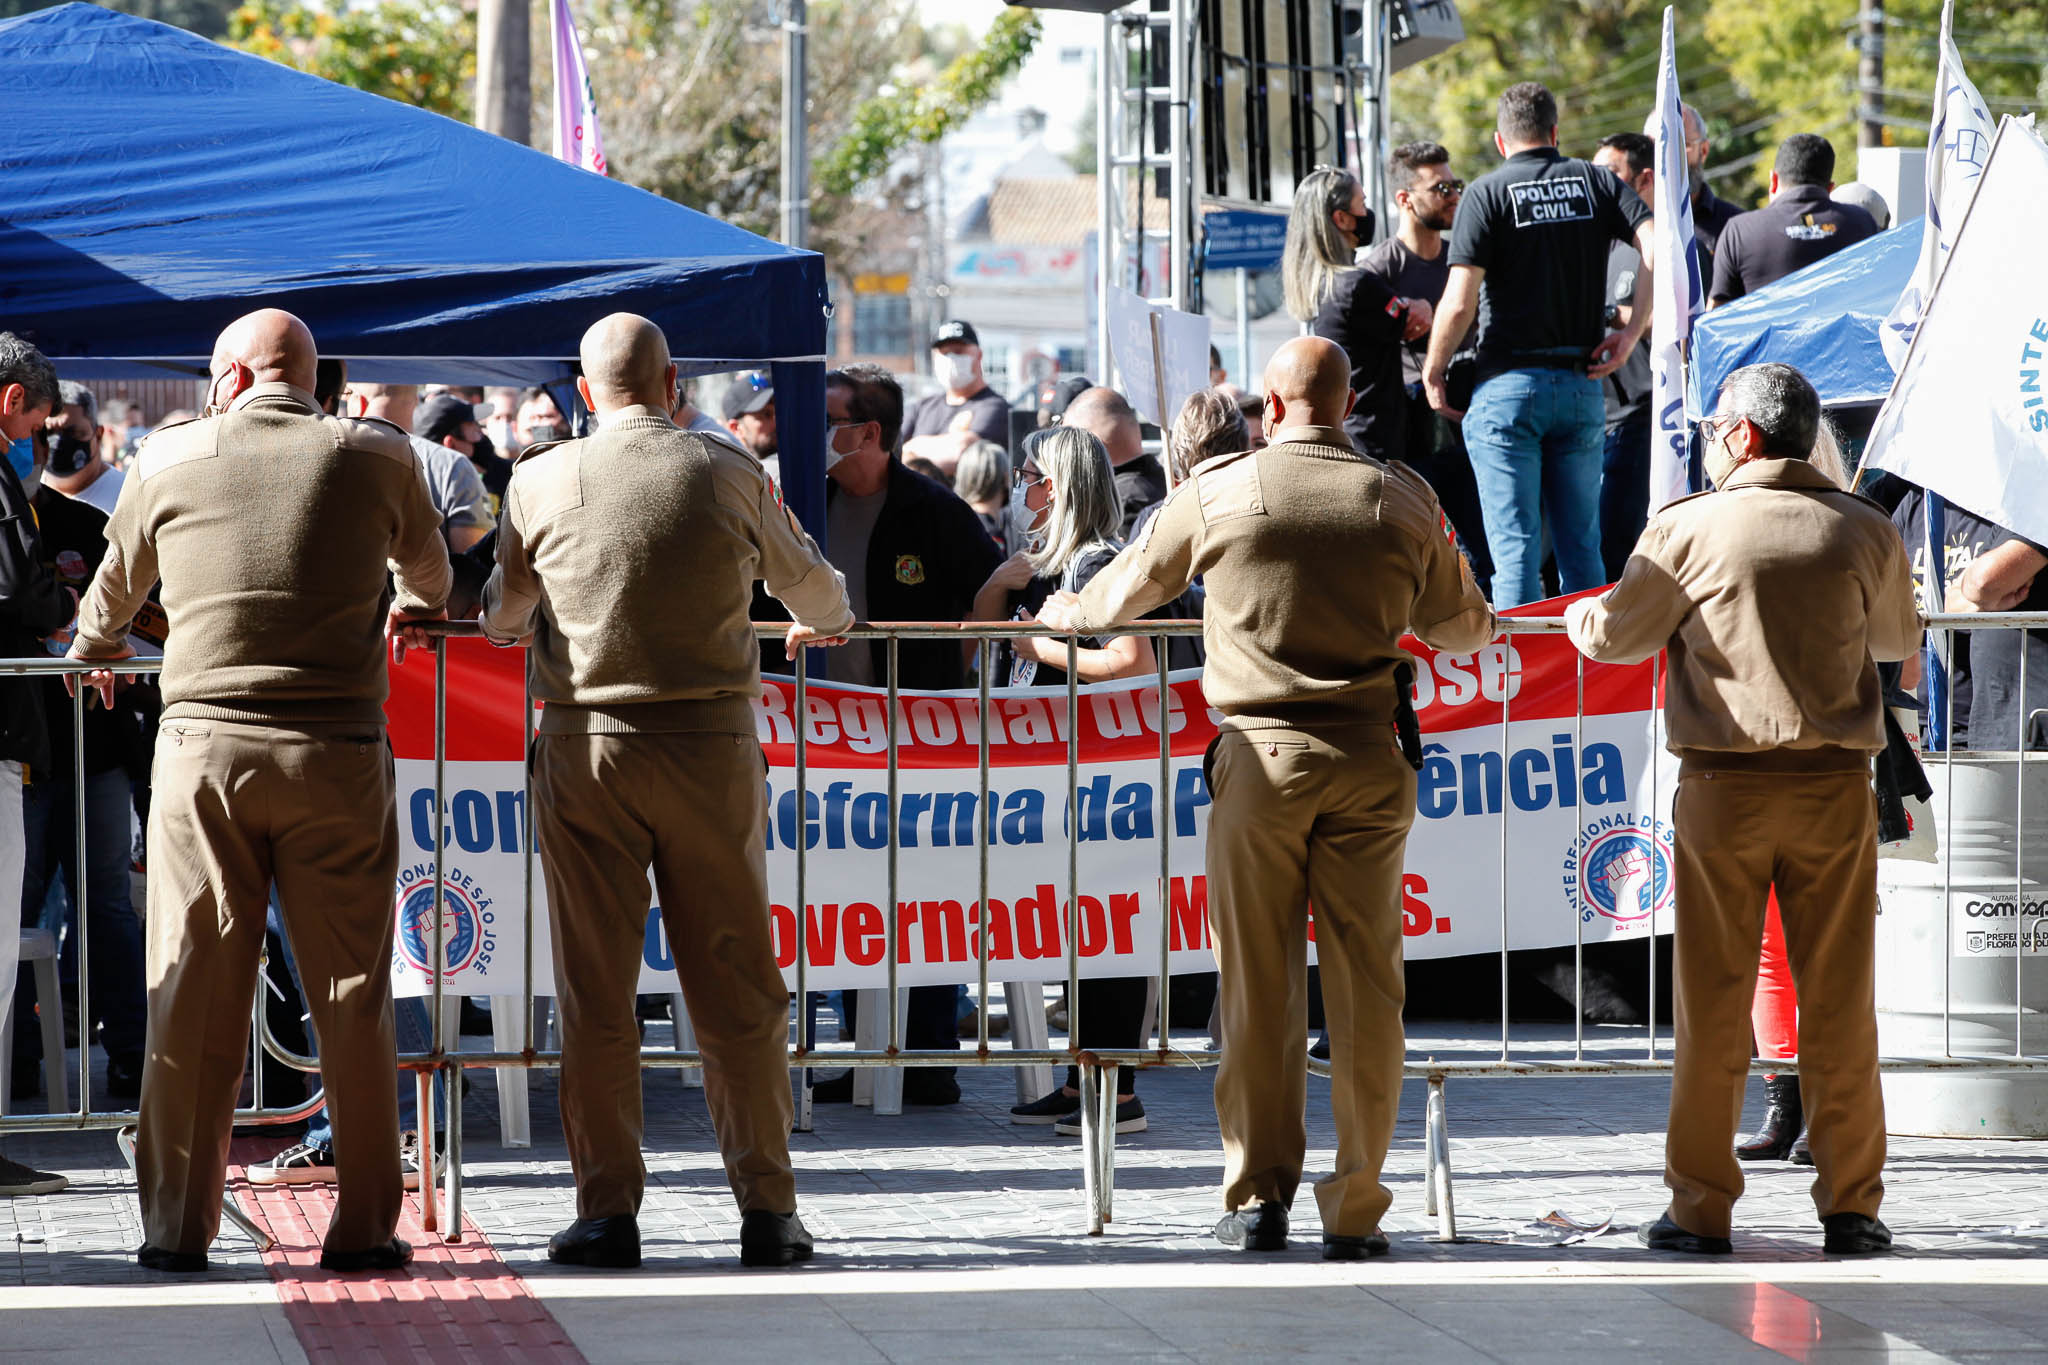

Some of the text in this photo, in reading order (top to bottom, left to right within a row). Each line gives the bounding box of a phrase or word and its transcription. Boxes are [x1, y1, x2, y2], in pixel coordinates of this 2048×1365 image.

[1532, 202, 1576, 219] CIVIL
[749, 682, 1079, 754] Regional
[1090, 686, 1187, 739] de
[1063, 774, 1155, 842] da
[1563, 812, 1637, 871] REGIONAL
[450, 867, 474, 890] DE
[471, 887, 495, 924] SÃO
[770, 883, 1140, 969] overnador
[473, 930, 497, 976] JOSÉ
